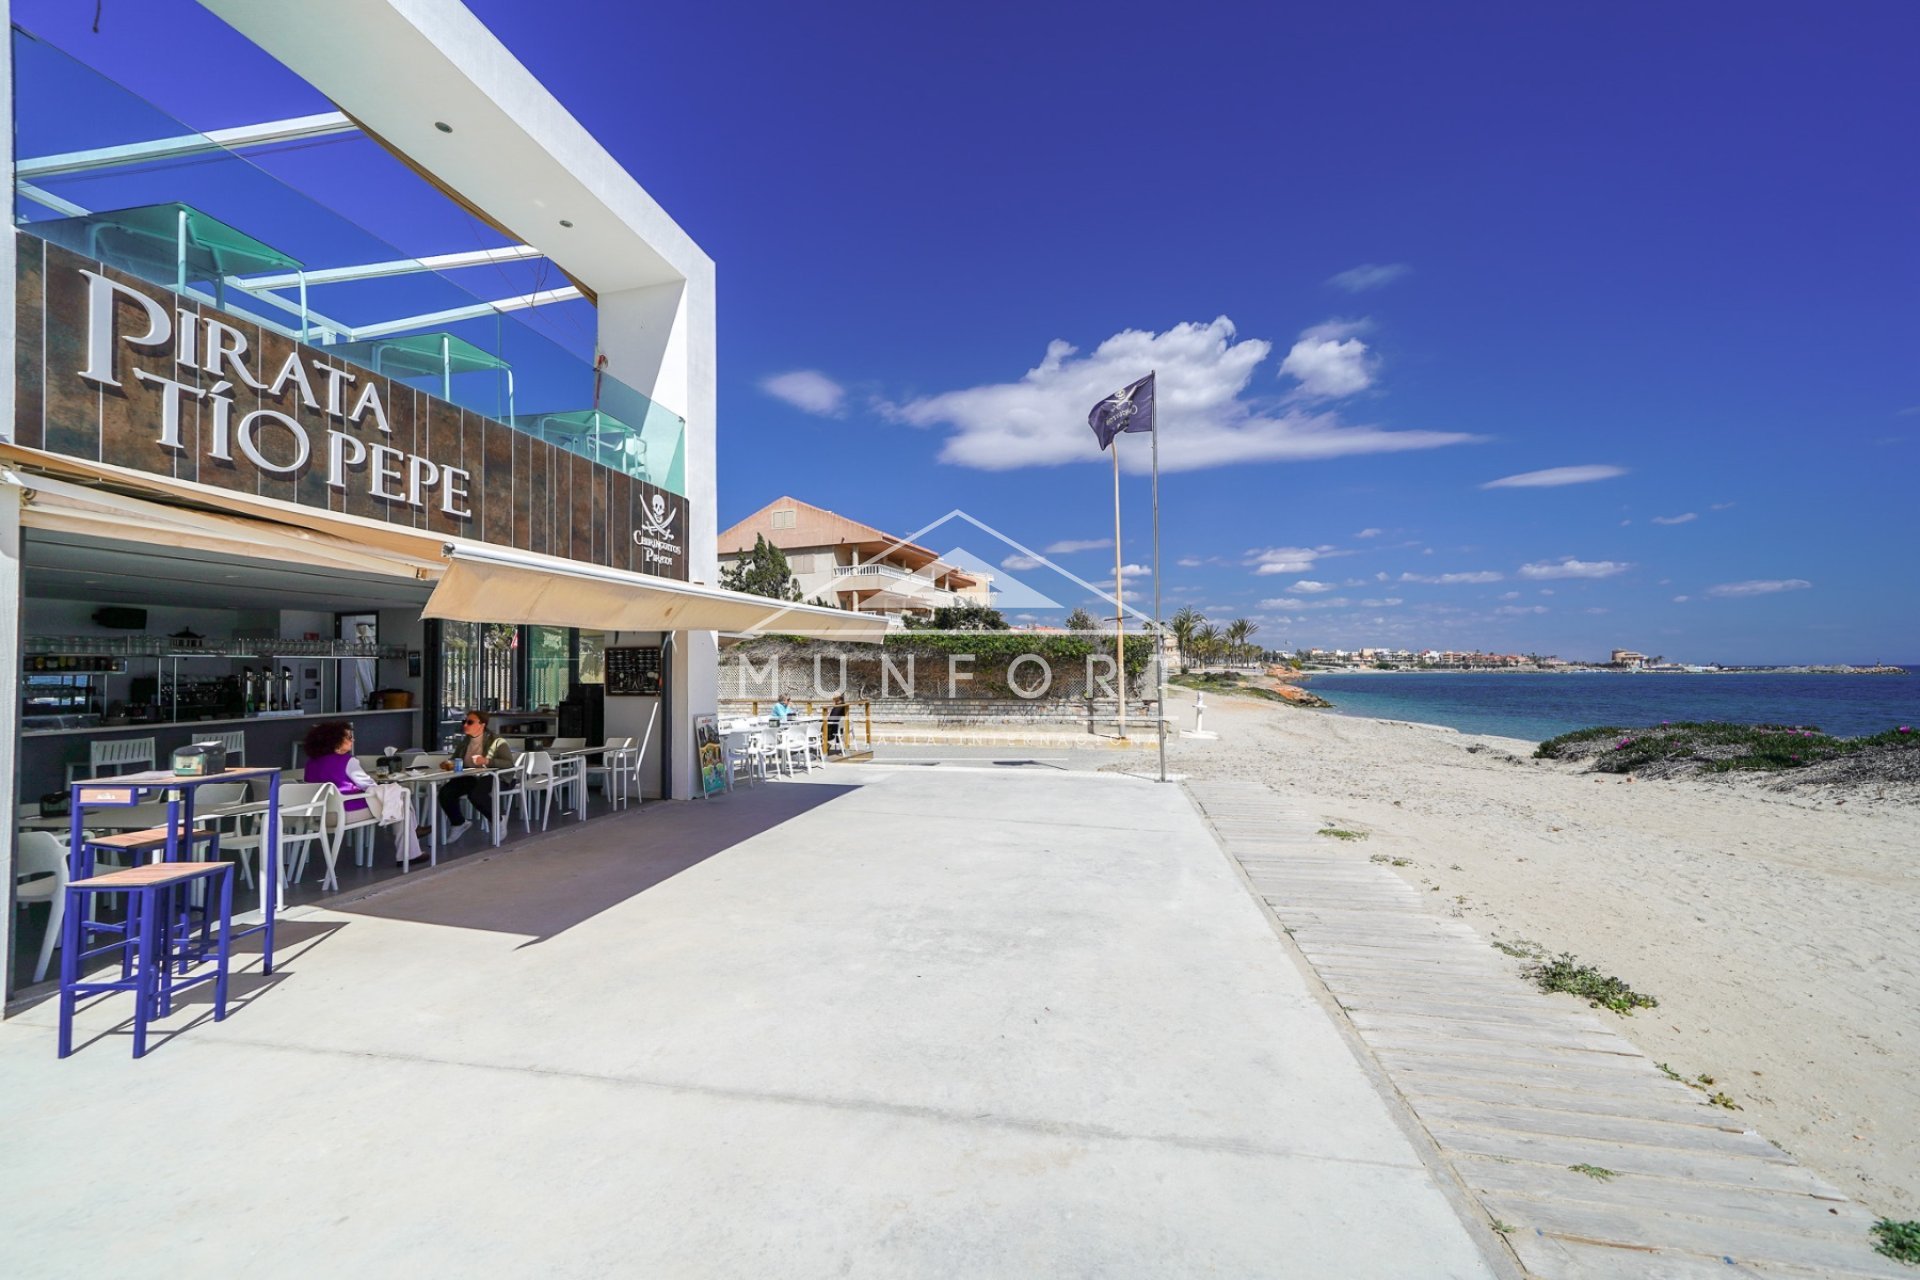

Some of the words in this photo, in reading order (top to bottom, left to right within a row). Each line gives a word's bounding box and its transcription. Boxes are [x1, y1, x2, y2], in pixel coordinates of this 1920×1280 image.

[78, 269, 392, 433] PIRATA
[132, 366, 310, 473] TÍO
[326, 429, 472, 518] PEPE
